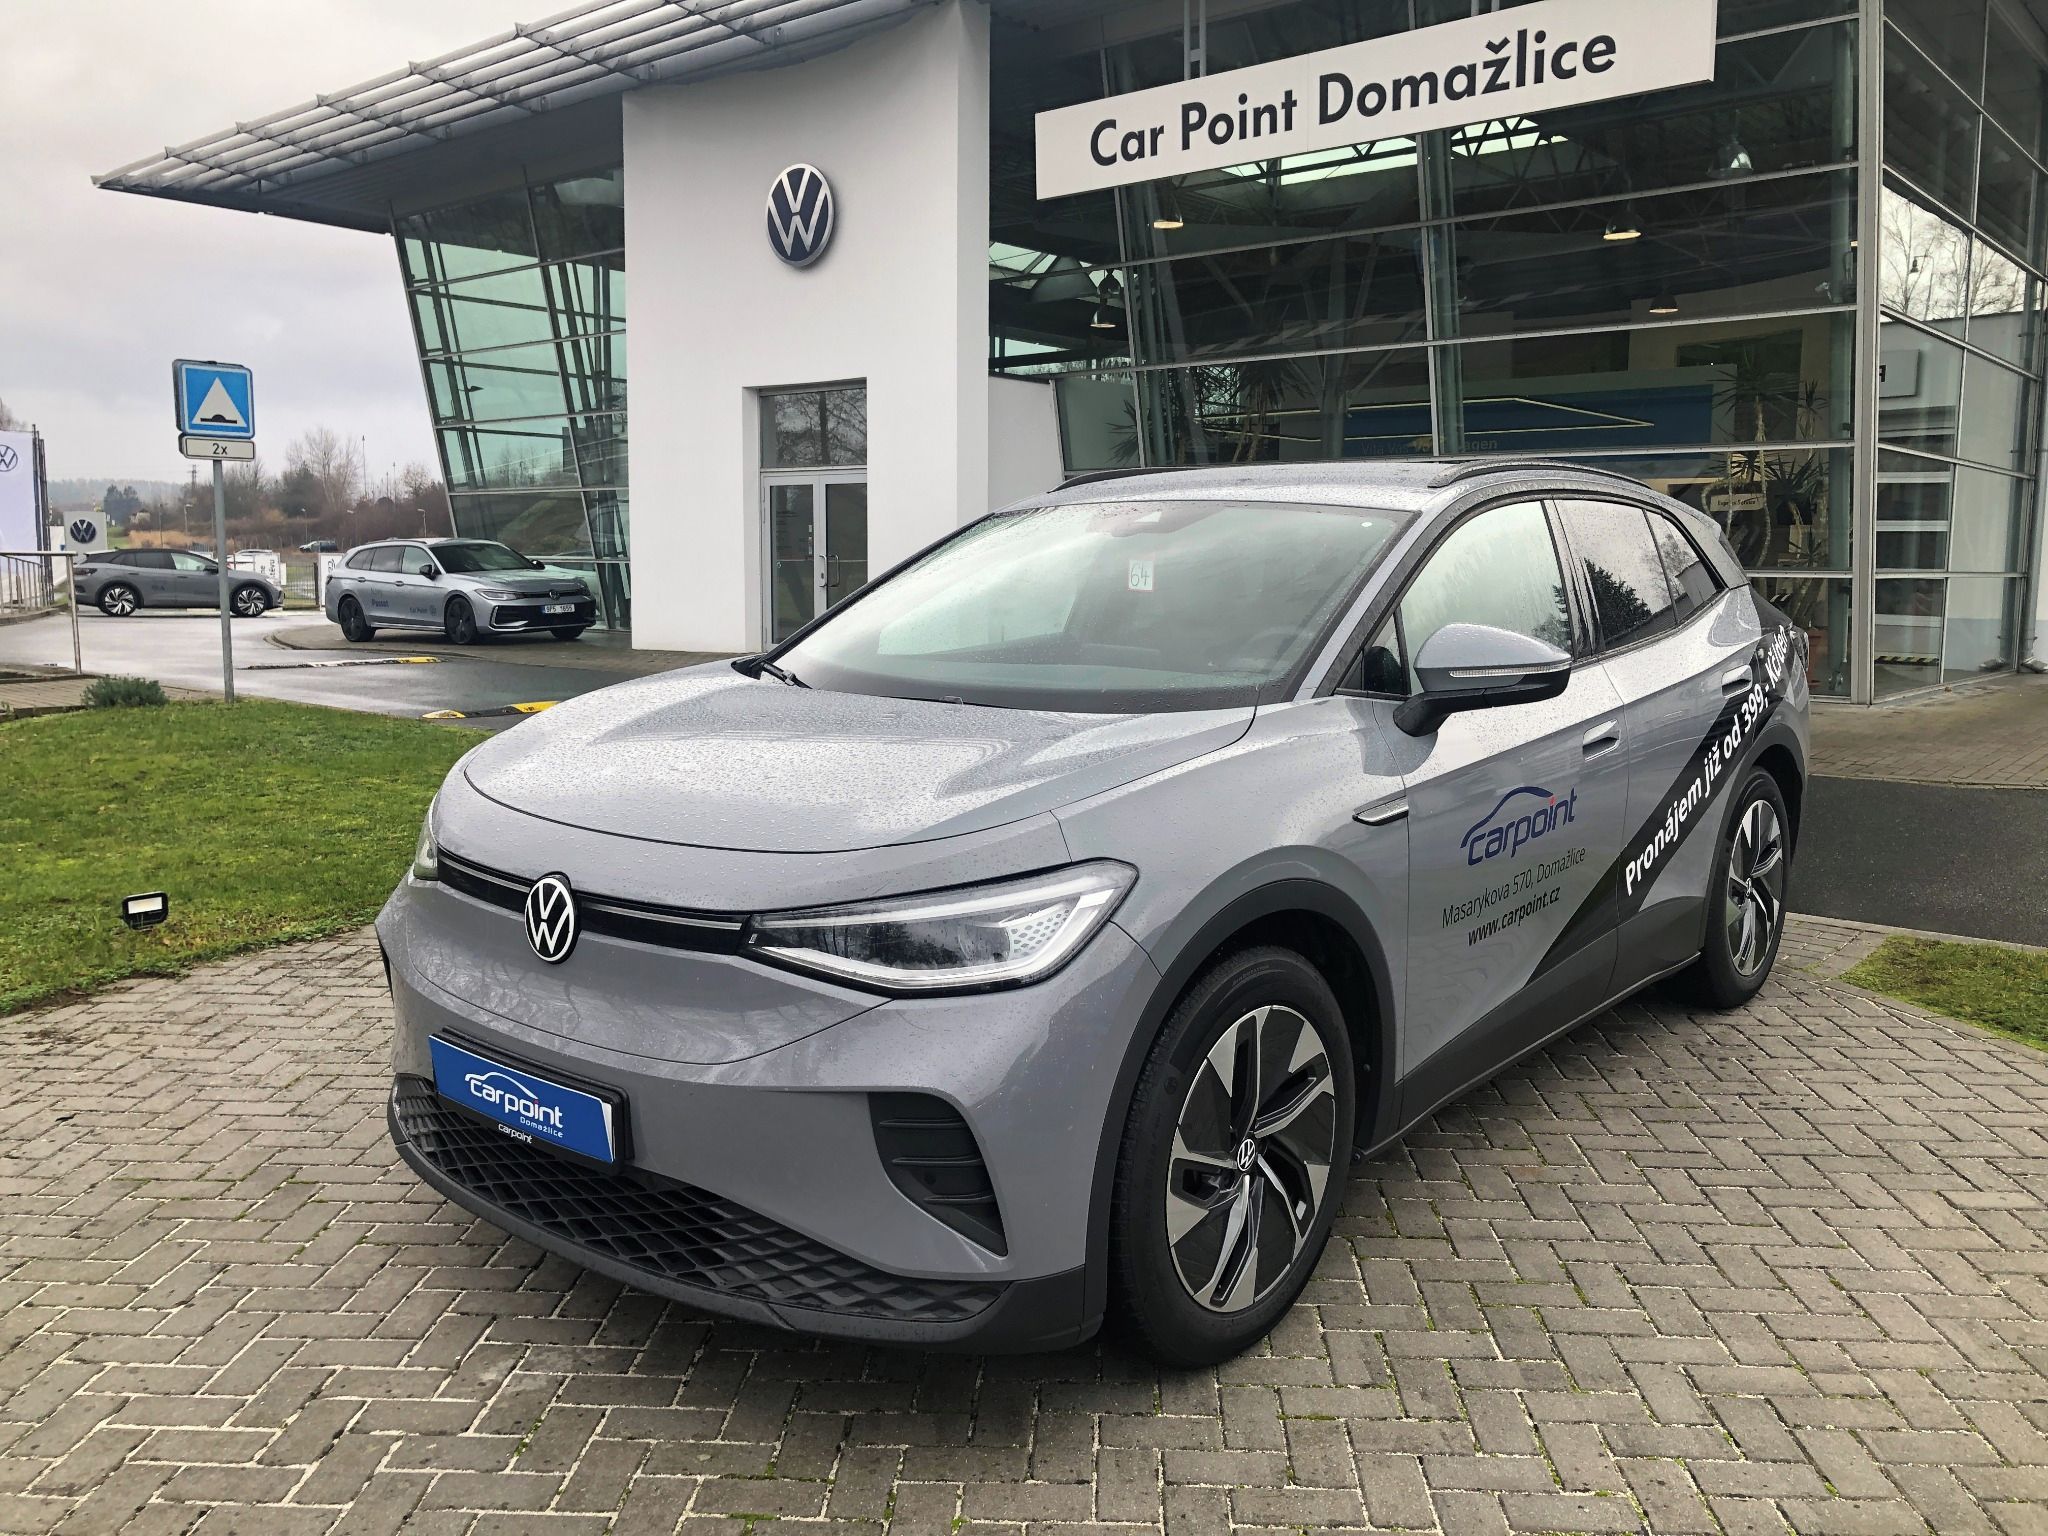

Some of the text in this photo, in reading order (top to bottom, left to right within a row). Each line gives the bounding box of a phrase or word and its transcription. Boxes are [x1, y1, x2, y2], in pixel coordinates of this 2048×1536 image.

[1090, 29, 1617, 167] Car Point Domažlice
[212, 442, 228, 455] 2x
[1130, 561, 1150, 587] 64
[1467, 787, 1577, 866] carpoint
[1625, 777, 1702, 897] Pronájem
[1704, 740, 1722, 798] již
[1723, 713, 1741, 759] od
[1442, 847, 1586, 929] Masarykova 570, Domažlice
[1468, 886, 1561, 946] www.carpoint.cz
[469, 1077, 564, 1129] carpoint
[520, 1116, 564, 1138] Domažlice
[498, 1123, 533, 1144] carpoint
